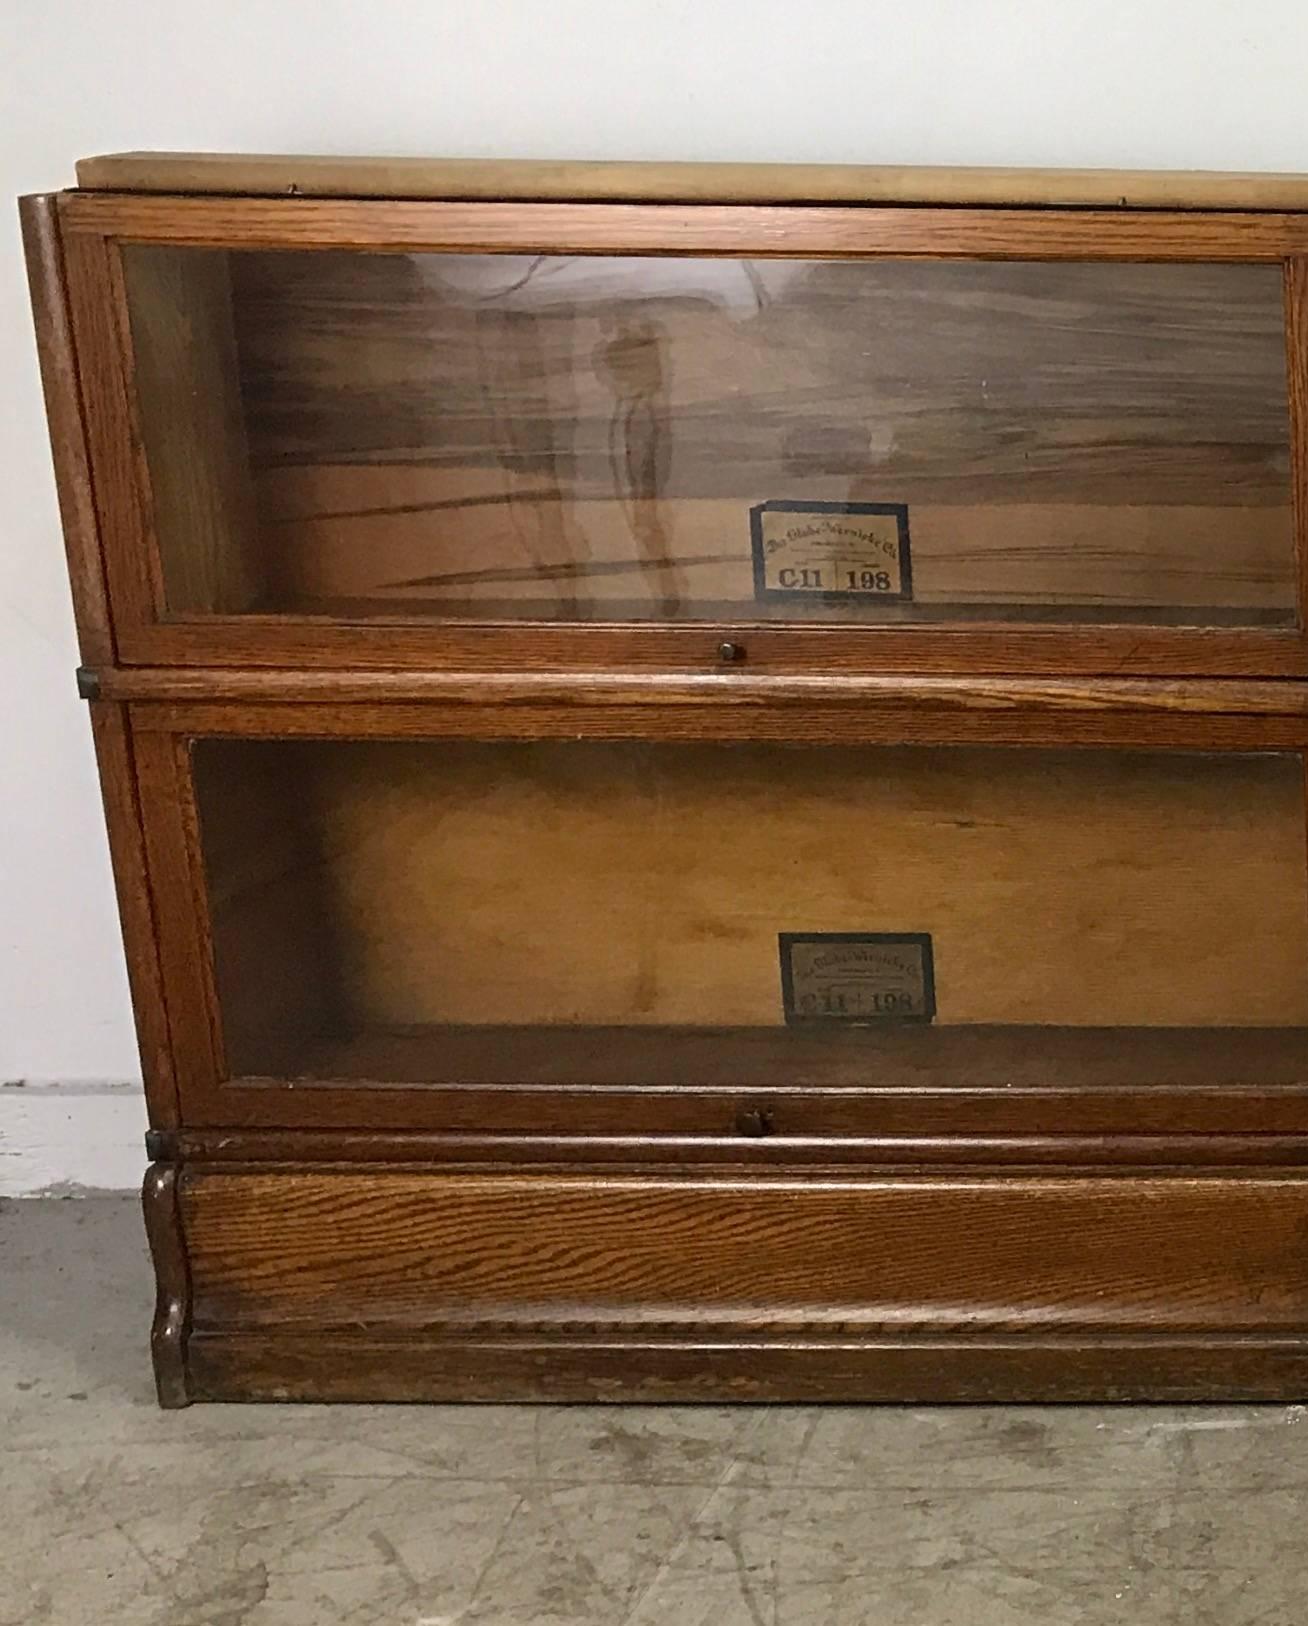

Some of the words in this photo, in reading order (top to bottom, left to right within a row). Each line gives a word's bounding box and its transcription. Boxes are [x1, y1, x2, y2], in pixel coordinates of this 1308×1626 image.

[779, 568, 824, 588] C11
[846, 571, 891, 591] 198
[871, 993, 913, 1012] 198
